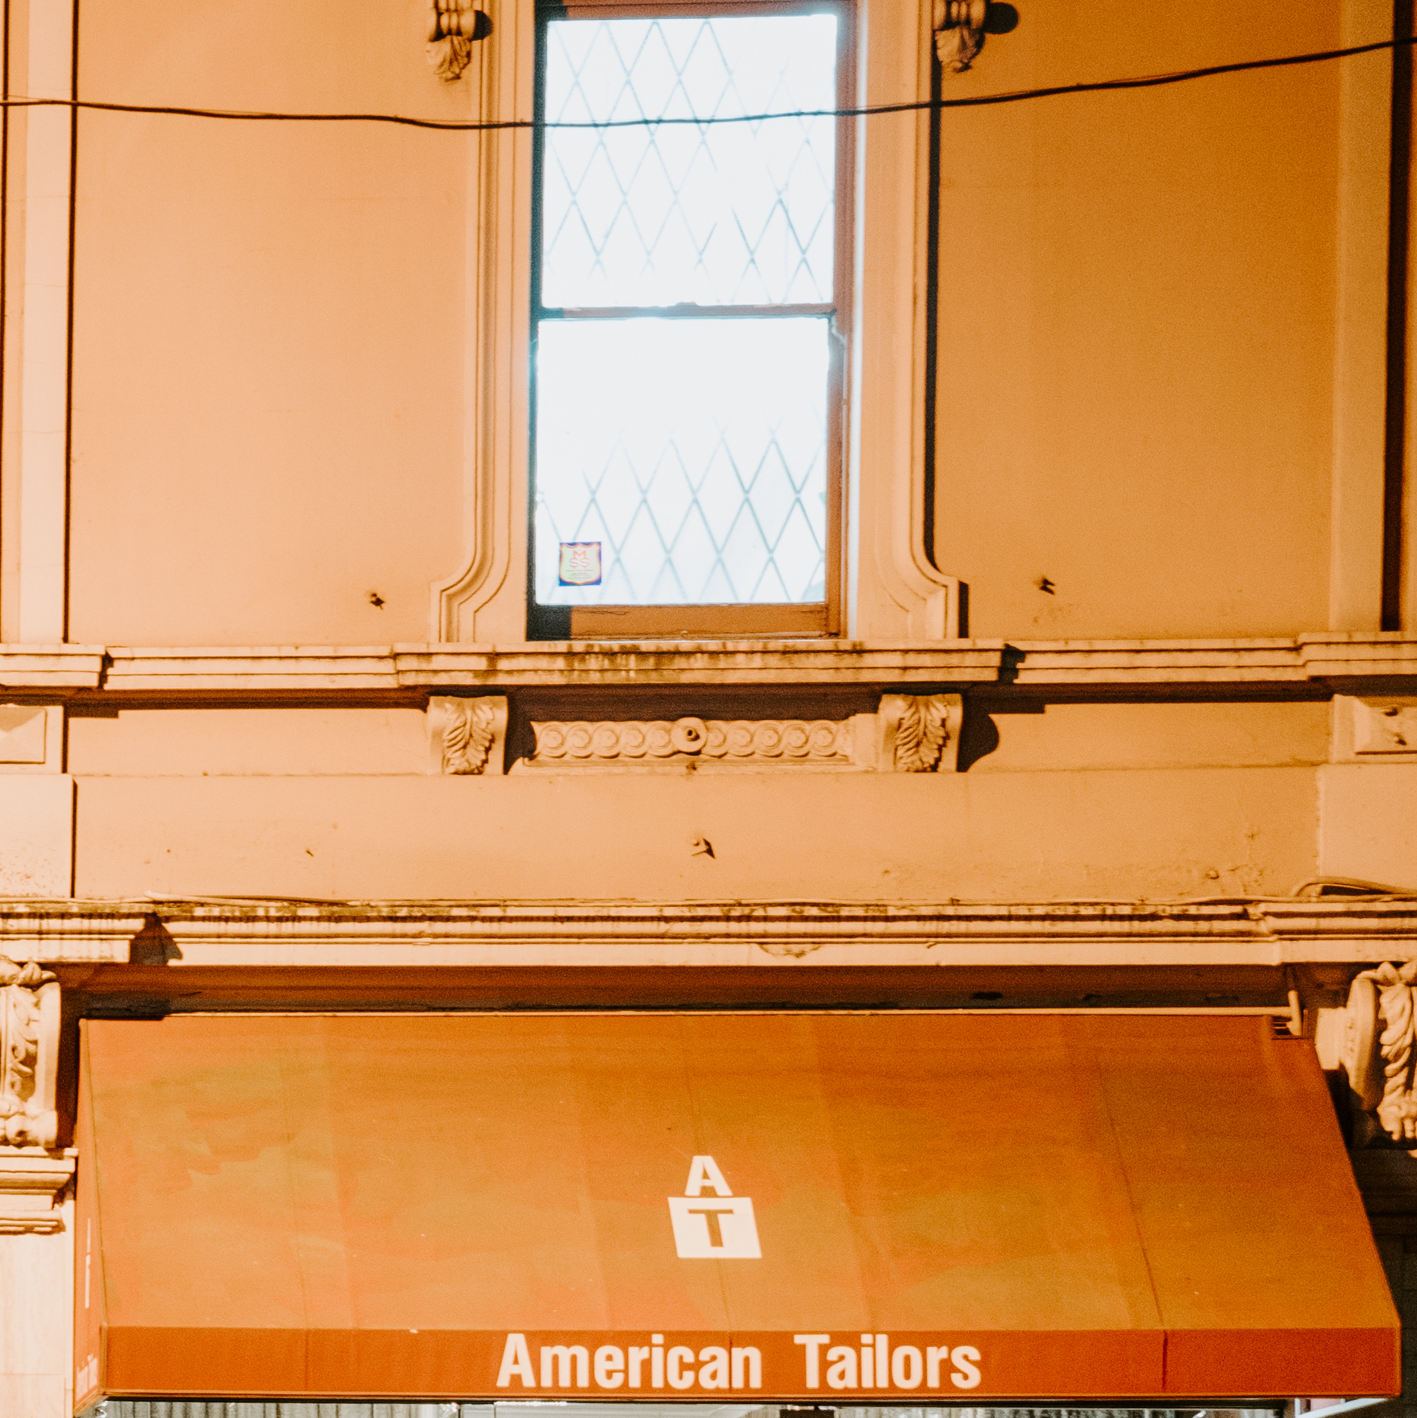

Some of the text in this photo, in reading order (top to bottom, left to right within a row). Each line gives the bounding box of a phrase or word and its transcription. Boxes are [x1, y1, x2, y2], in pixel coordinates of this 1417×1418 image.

[685, 1156, 733, 1196] A
[688, 1208, 735, 1248] T
[496, 1333, 982, 1390] American Tailors
